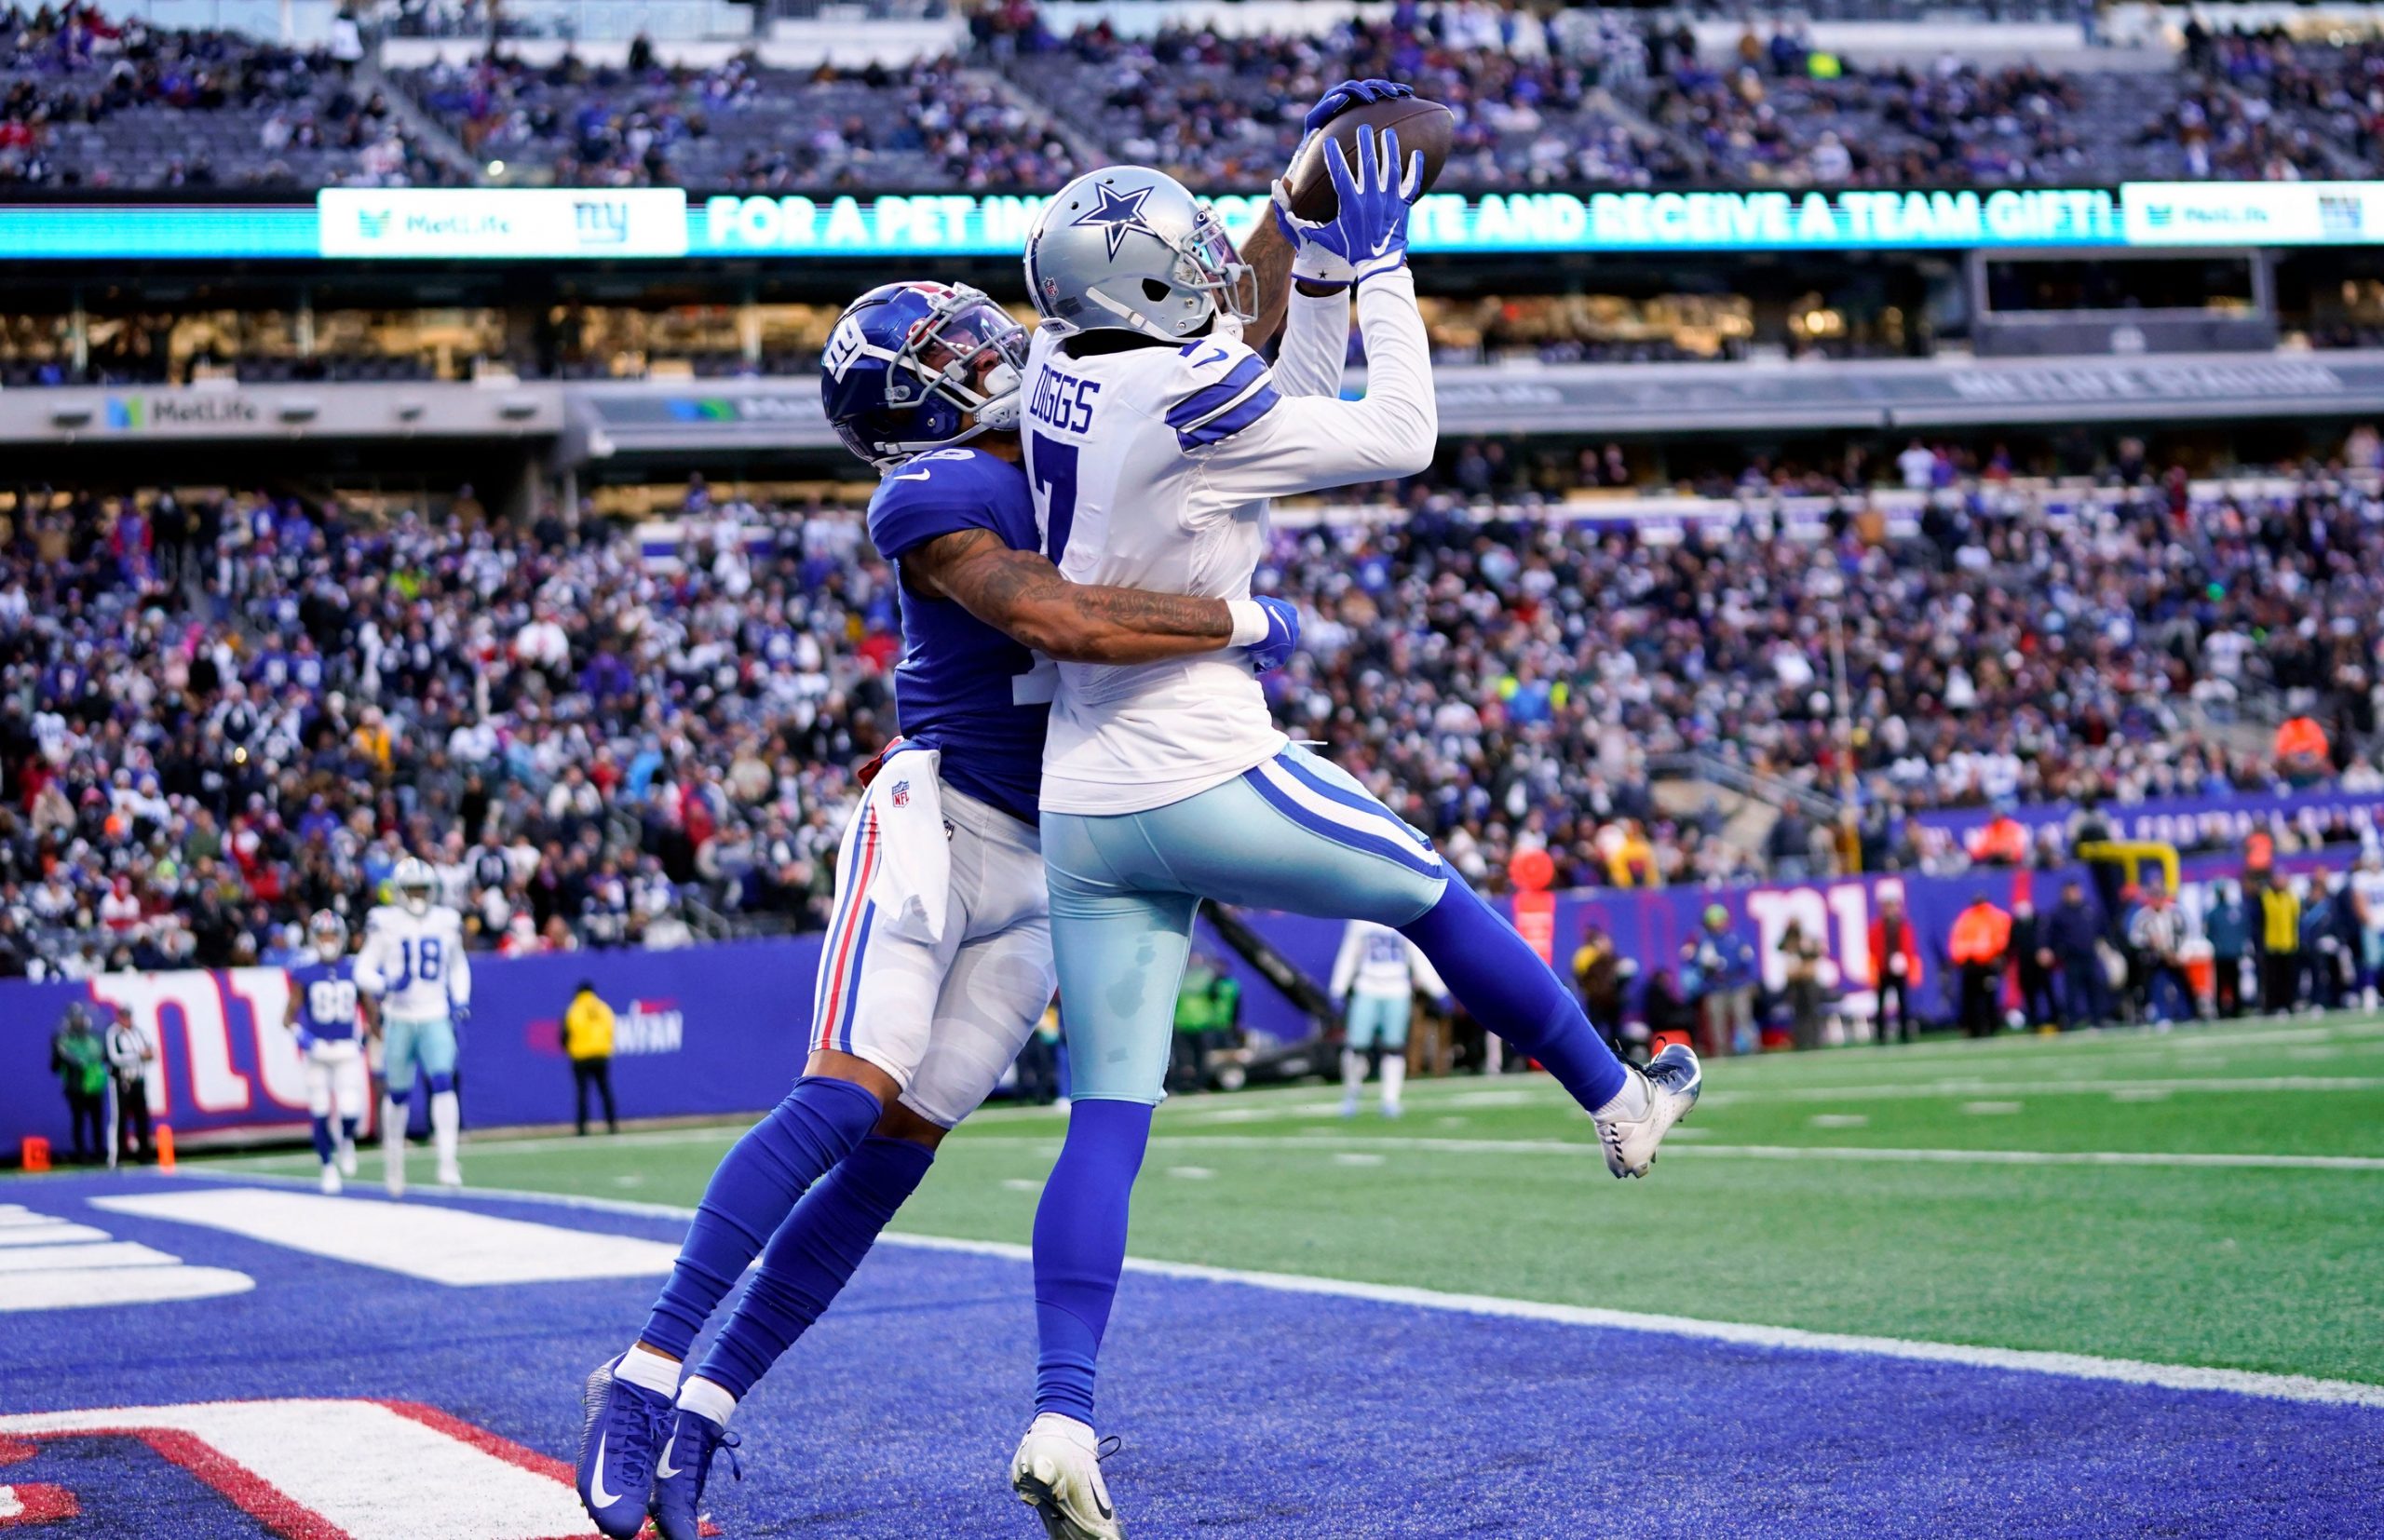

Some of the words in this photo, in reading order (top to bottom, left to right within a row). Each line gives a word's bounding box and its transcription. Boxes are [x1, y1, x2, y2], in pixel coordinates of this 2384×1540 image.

[706, 195, 818, 248] FOR
[826, 195, 869, 246] A
[874, 195, 975, 246] PET
[1475, 192, 1585, 242] AND
[1589, 191, 1791, 242] RECEIVE
[1795, 191, 1840, 240] A
[1838, 191, 1983, 240] TEAM
[1984, 189, 2113, 239] GIFT!
[1029, 362, 1101, 435] DIGGS
[1032, 428, 1079, 568] 7
[894, 790, 910, 806] NFL
[401, 937, 440, 980] 18
[309, 979, 358, 1024] 88
